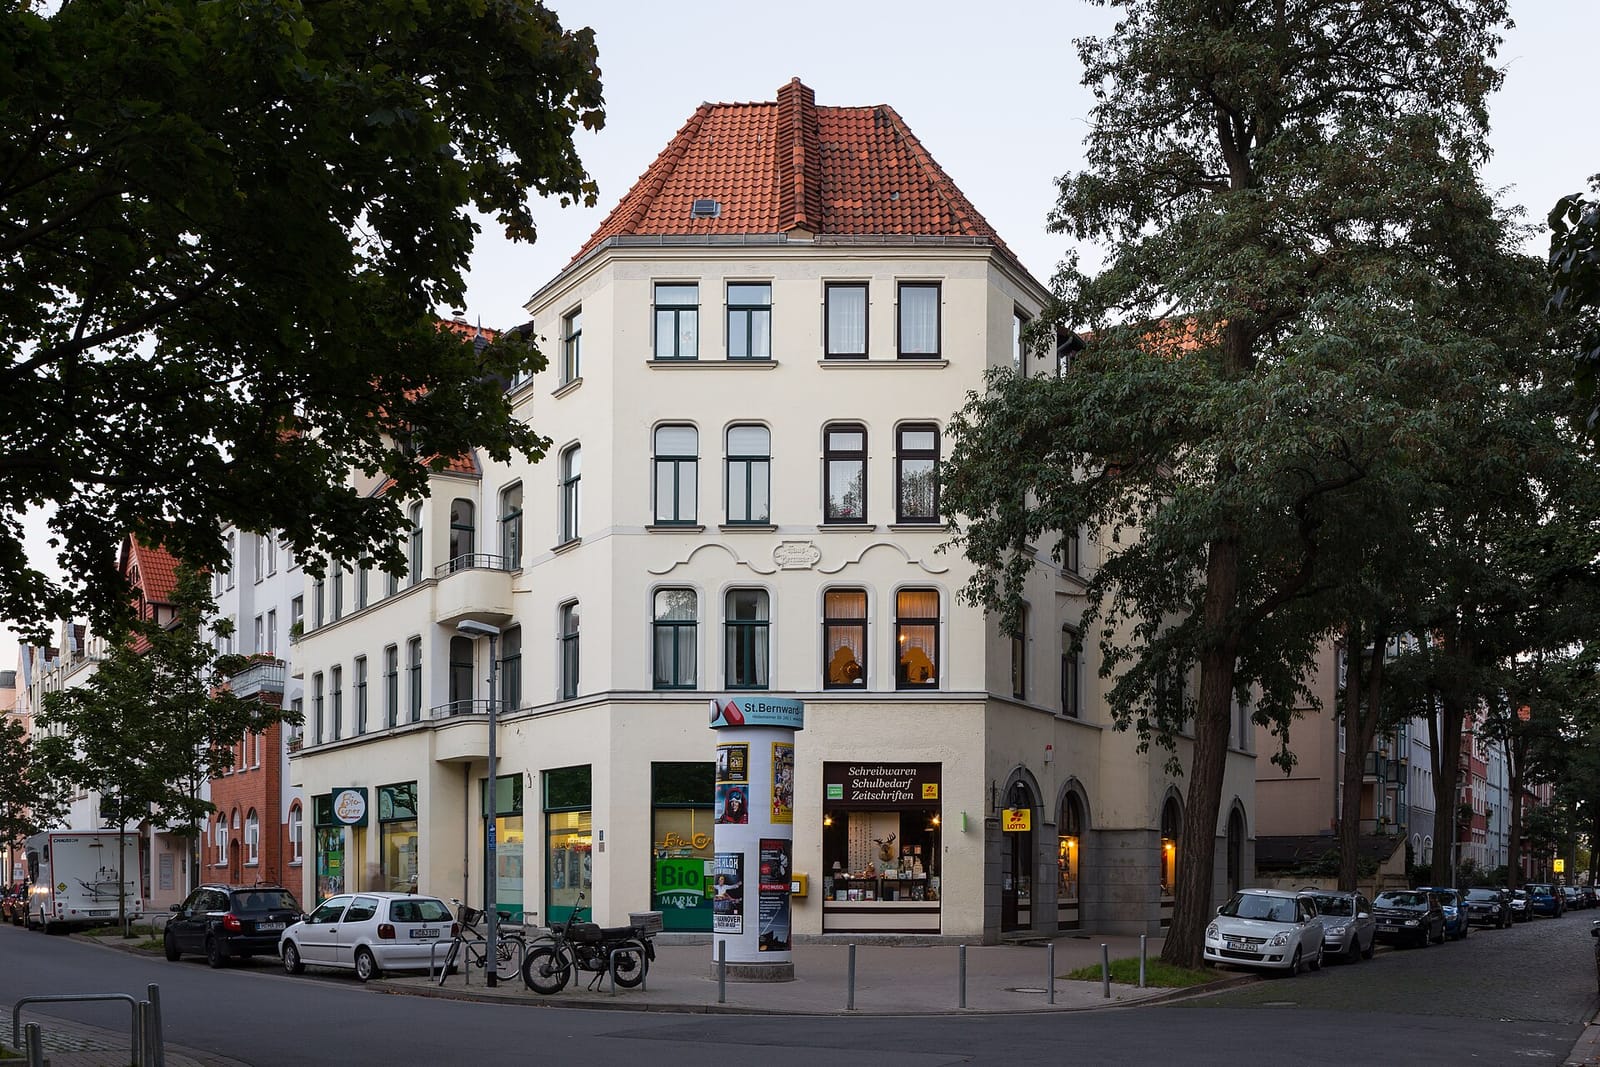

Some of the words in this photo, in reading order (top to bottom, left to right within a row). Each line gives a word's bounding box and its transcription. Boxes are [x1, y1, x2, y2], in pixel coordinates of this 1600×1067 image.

[848, 766, 917, 776] Schreibwaren
[852, 778, 913, 790] Schulbedarf
[851, 790, 914, 802] Zeitschriften
[661, 865, 699, 886] Bio
[661, 895, 699, 905] MARKT
